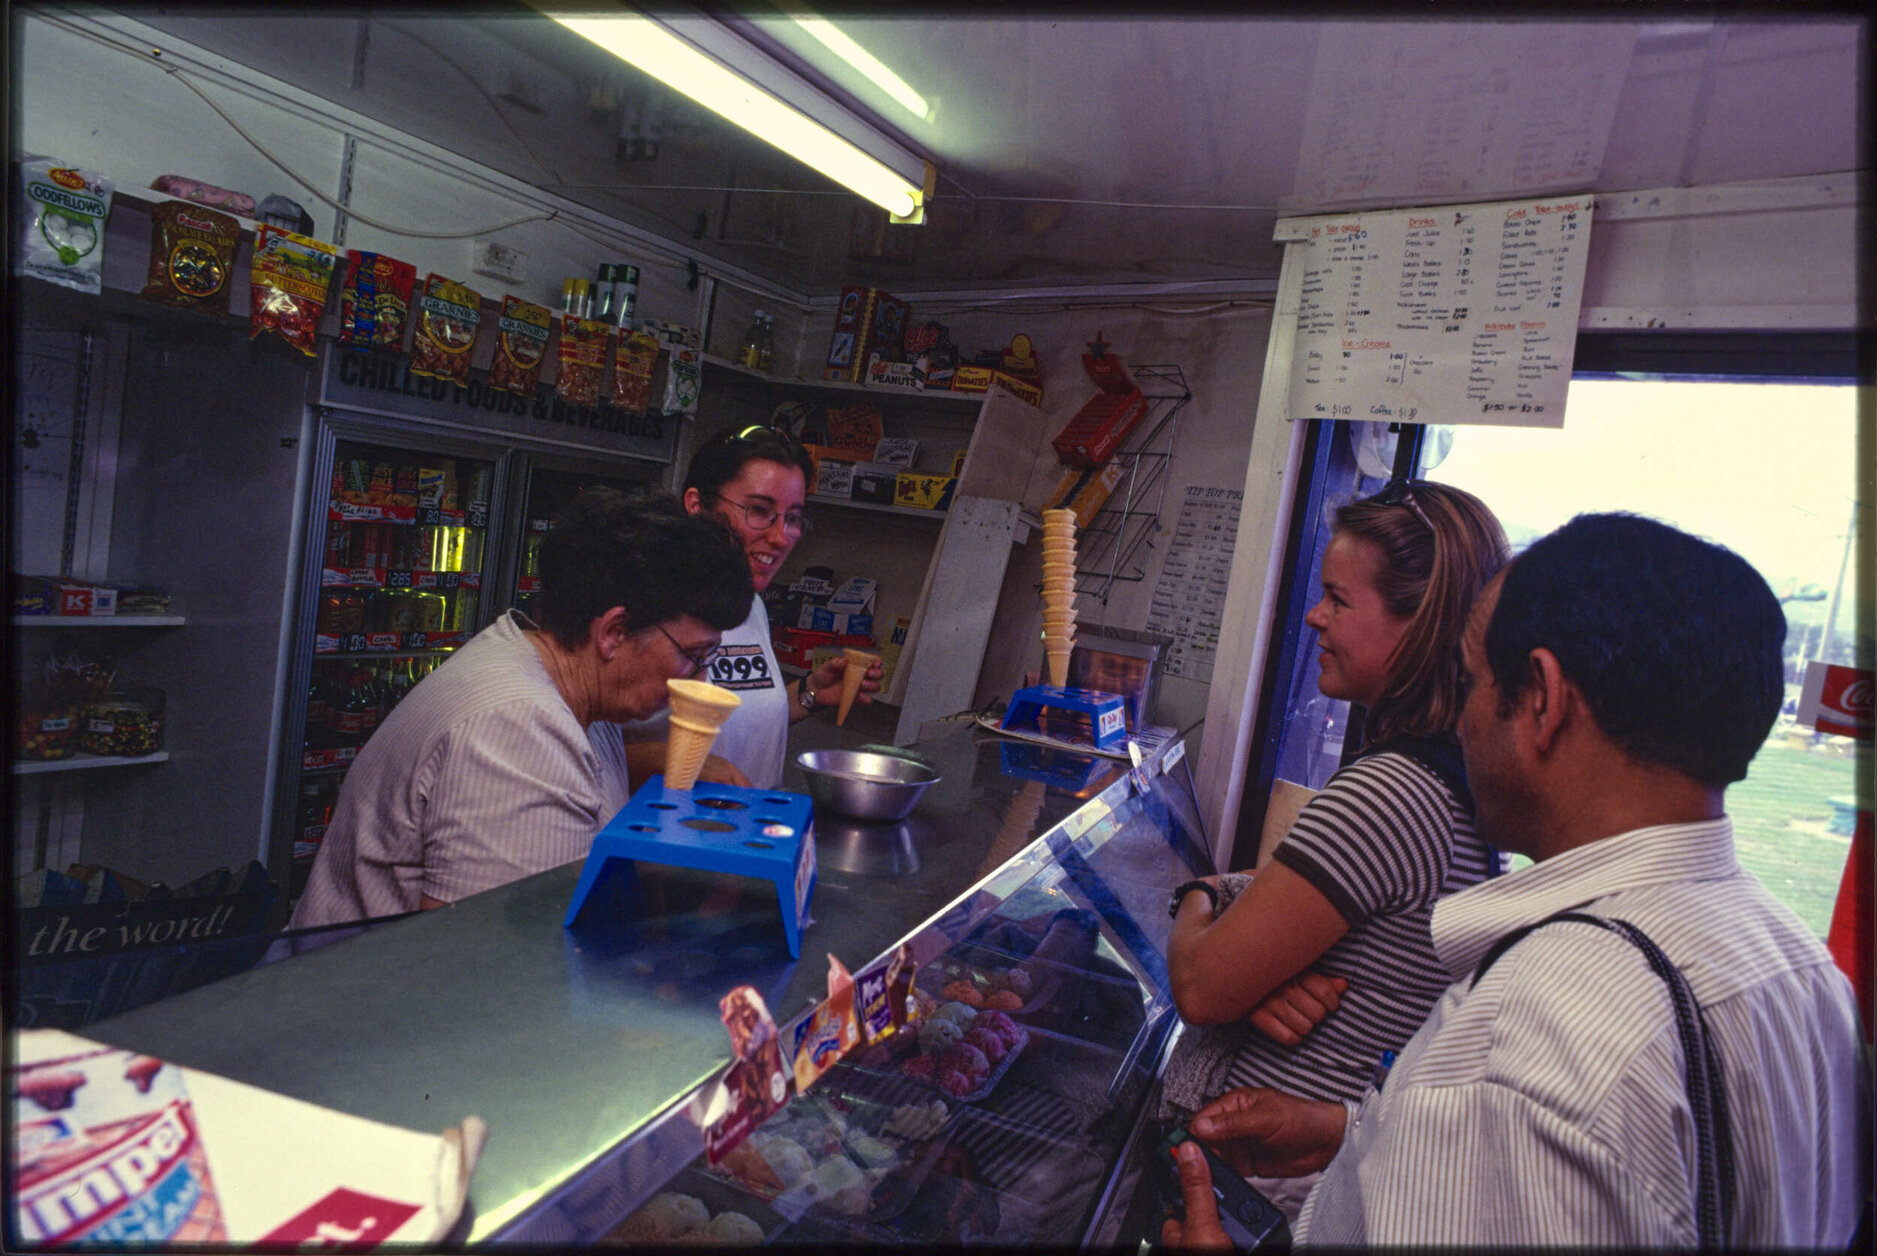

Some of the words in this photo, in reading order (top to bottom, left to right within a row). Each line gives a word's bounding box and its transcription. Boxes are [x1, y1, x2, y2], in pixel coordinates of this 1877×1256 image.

[33, 185, 104, 217] ODDFELLOWS
[1408, 217, 1436, 228] Drinks
[873, 373, 917, 387] PEANUTS
[28, 916, 108, 956] the
[116, 904, 235, 947] word!
